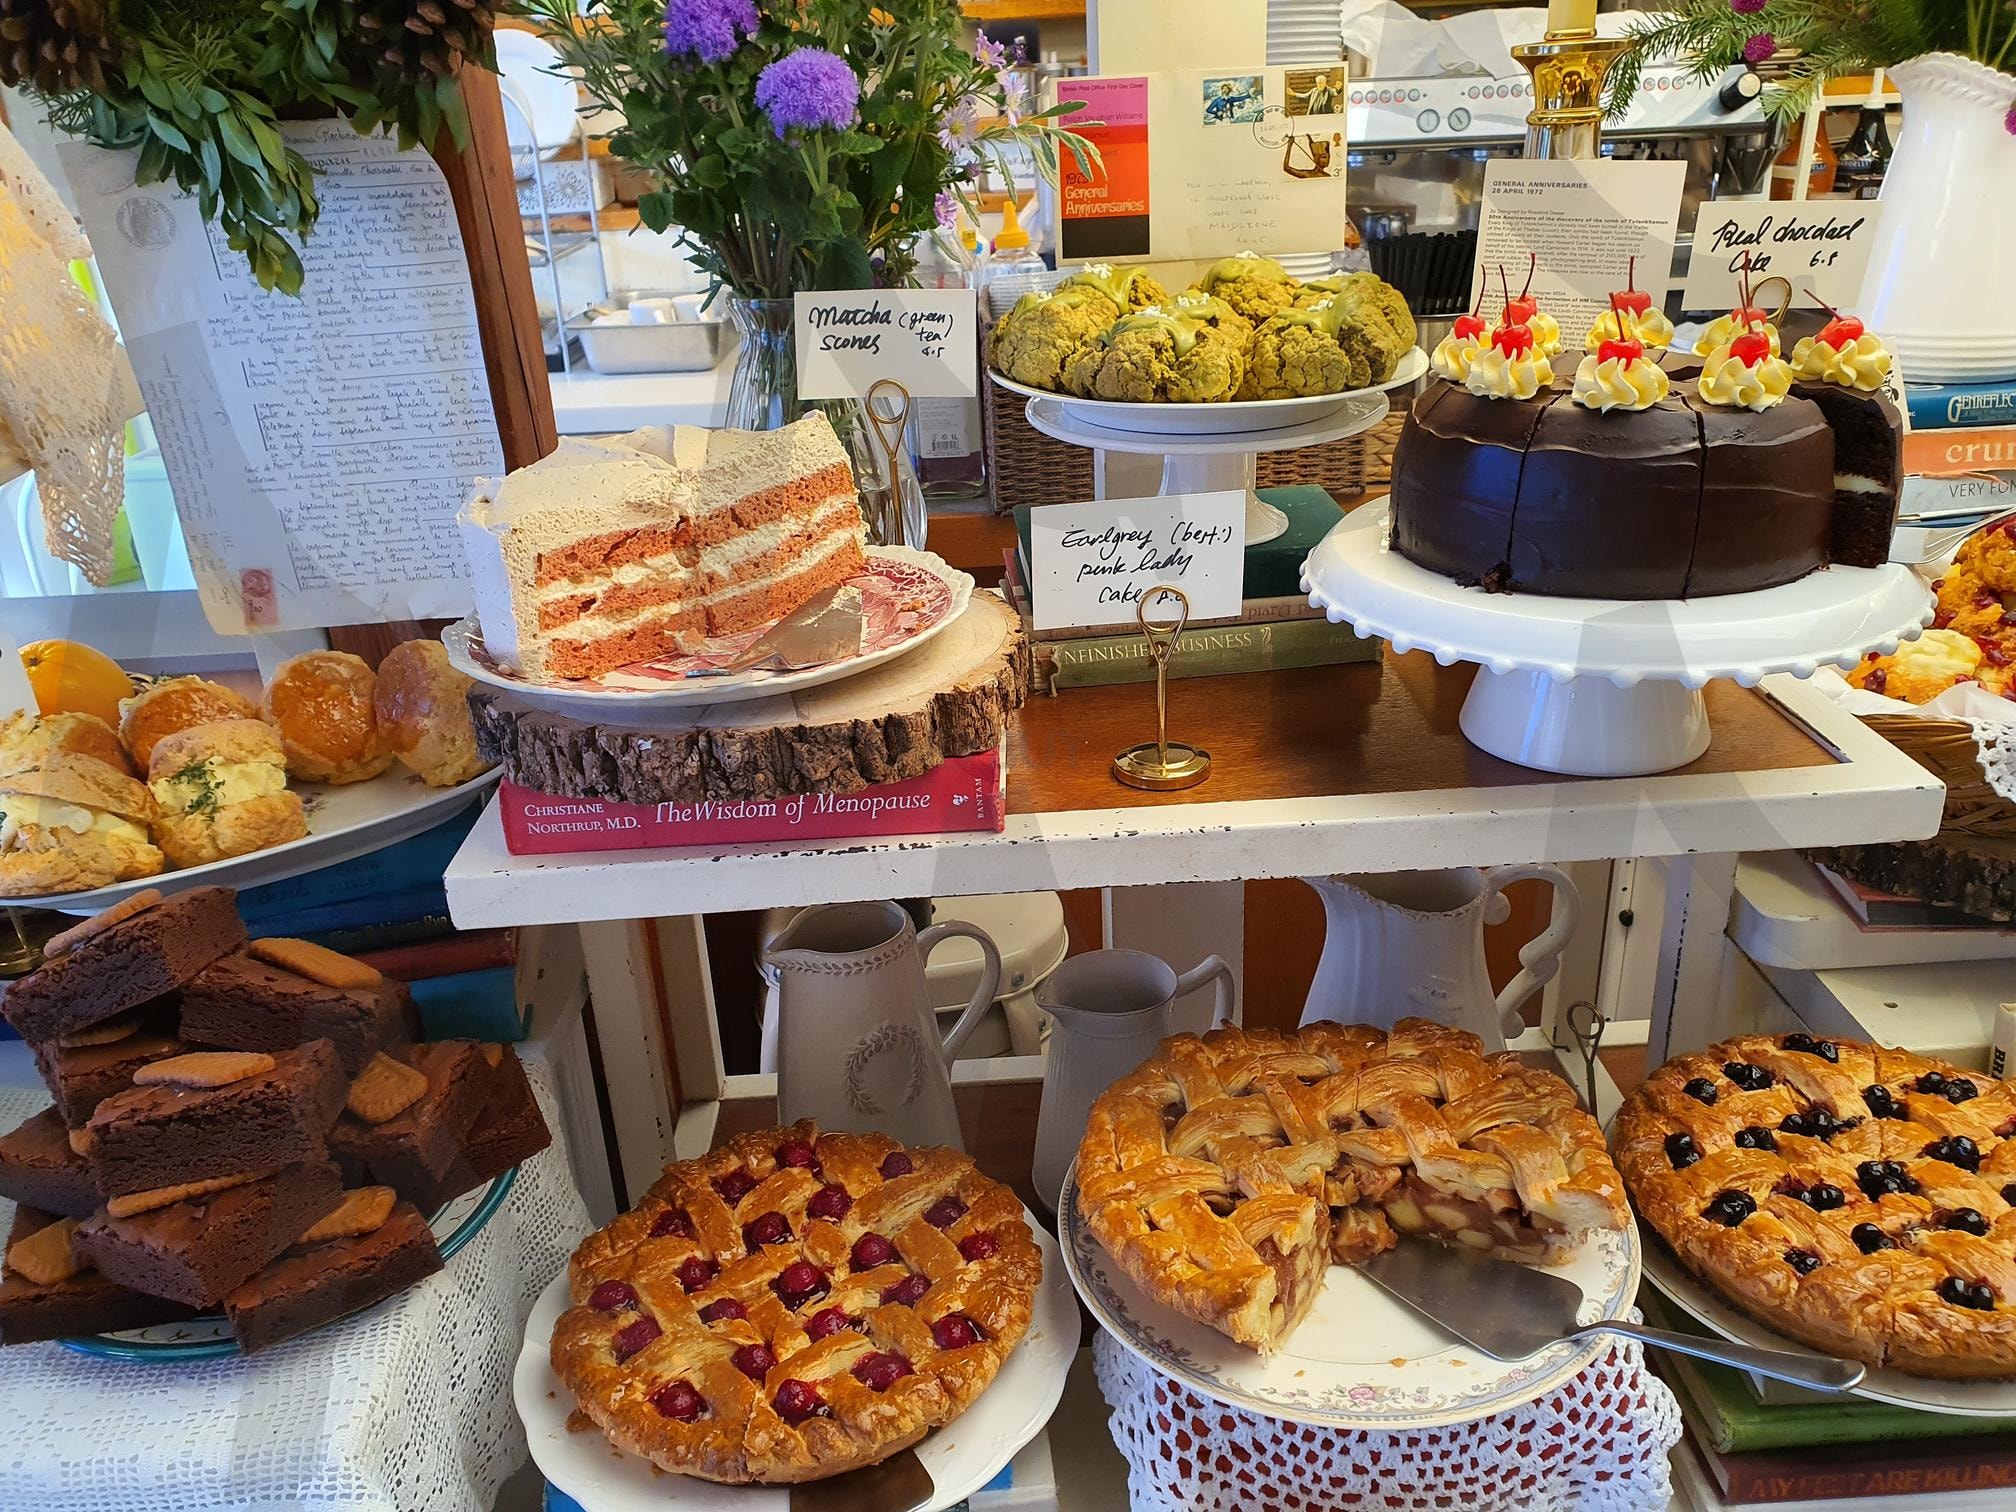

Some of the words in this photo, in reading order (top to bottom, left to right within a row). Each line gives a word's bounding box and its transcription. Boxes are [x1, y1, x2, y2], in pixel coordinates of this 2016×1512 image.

[1066, 184, 1108, 199] General
[1528, 181, 1588, 189] ANNIVERSARIES
[1066, 199, 1145, 216] Anniversaries
[1711, 215, 1773, 252] Real
[809, 299, 892, 329] Matcha
[820, 334, 881, 355] scones
[1950, 481, 1985, 498] VERY
[1130, 548, 1194, 576] lady
[655, 801, 692, 823] The
[694, 800, 777, 822] Wisdom
[785, 791, 810, 824] of
[813, 793, 931, 820] Menopause
[974, 777, 985, 820] BANTAM
[524, 803, 604, 817] CHRISTIANE
[527, 821, 604, 835] NORTHRUP,
[607, 816, 642, 831] M.D.
